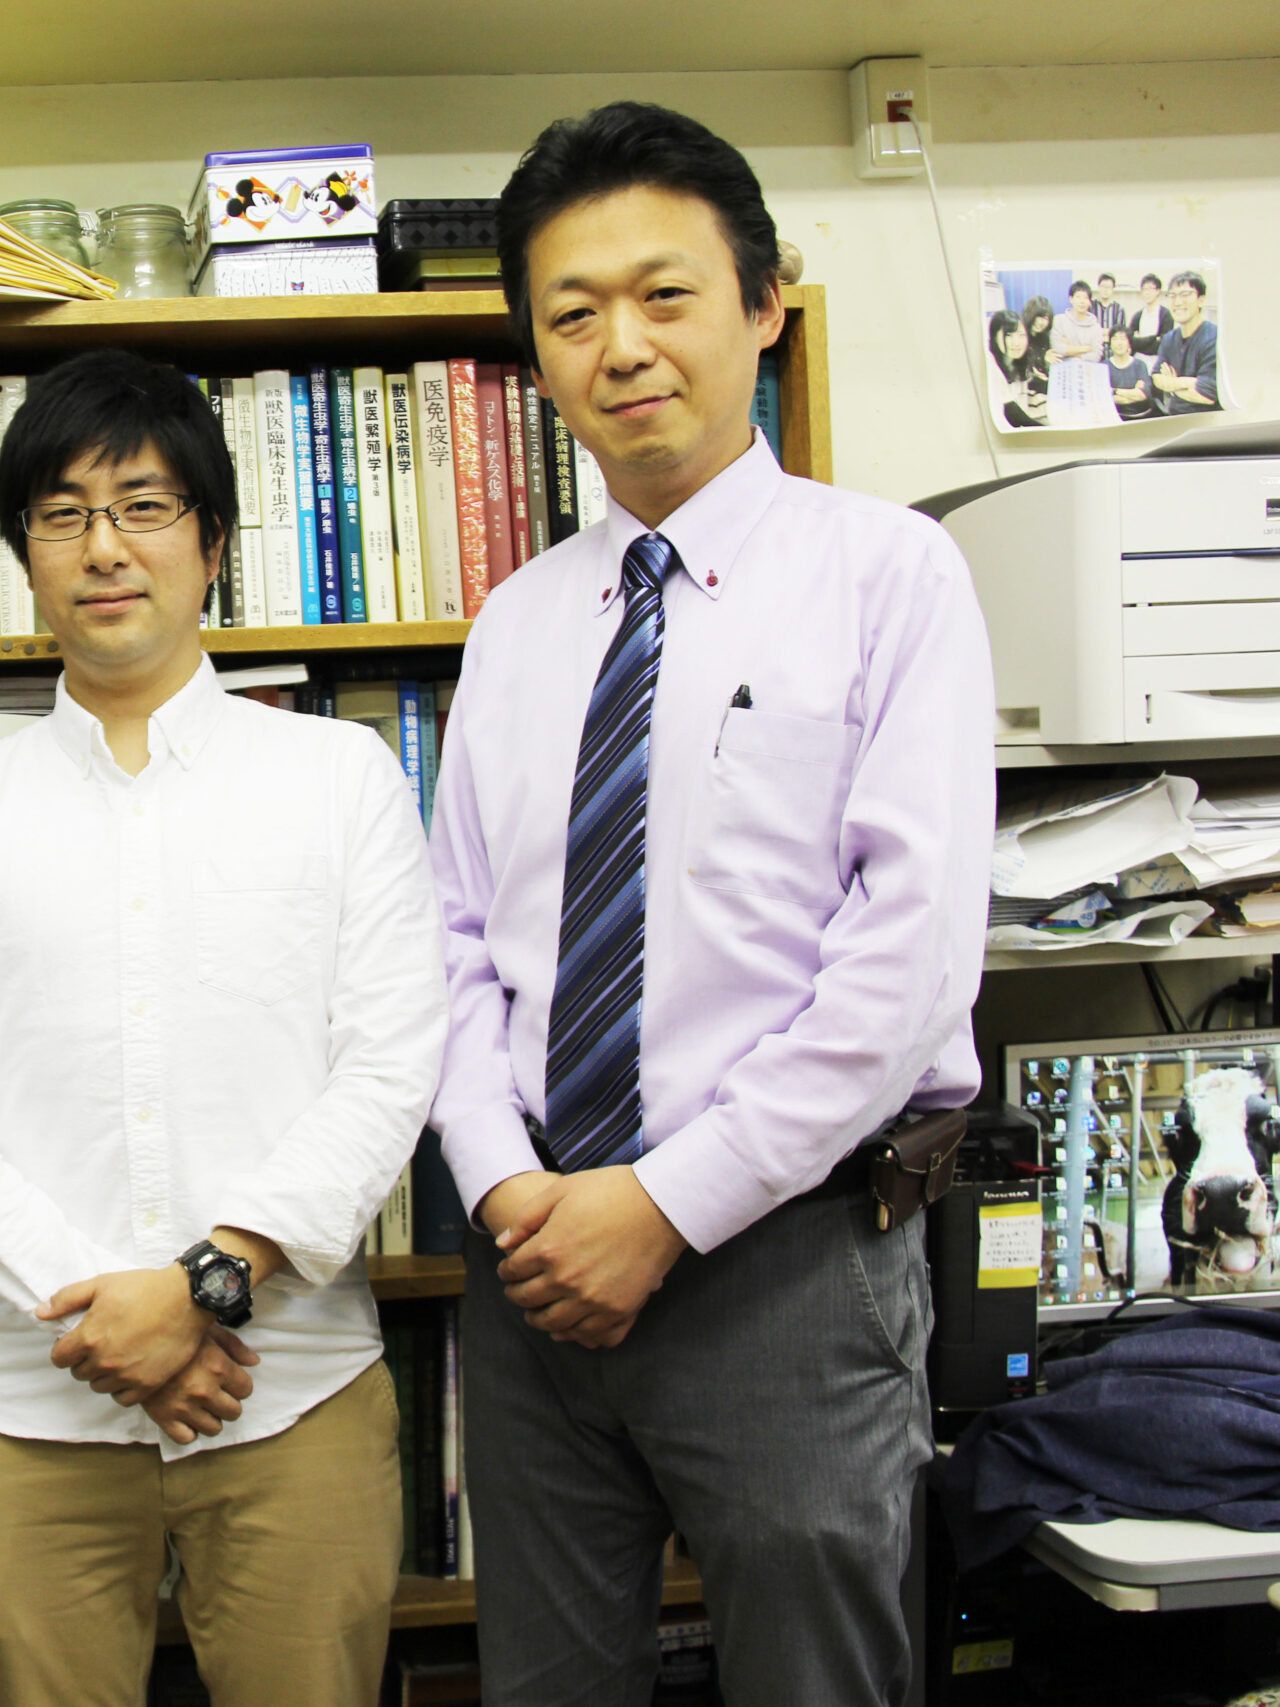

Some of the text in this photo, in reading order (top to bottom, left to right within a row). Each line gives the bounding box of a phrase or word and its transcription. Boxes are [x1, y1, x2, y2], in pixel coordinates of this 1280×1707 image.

[265, 399, 290, 522] 獣医臨床寄生虫学
[363, 389, 382, 471] 獣医繁殖学
[391, 383, 412, 475] 獣医伝染病学
[423, 379, 449, 467] 医免疫学
